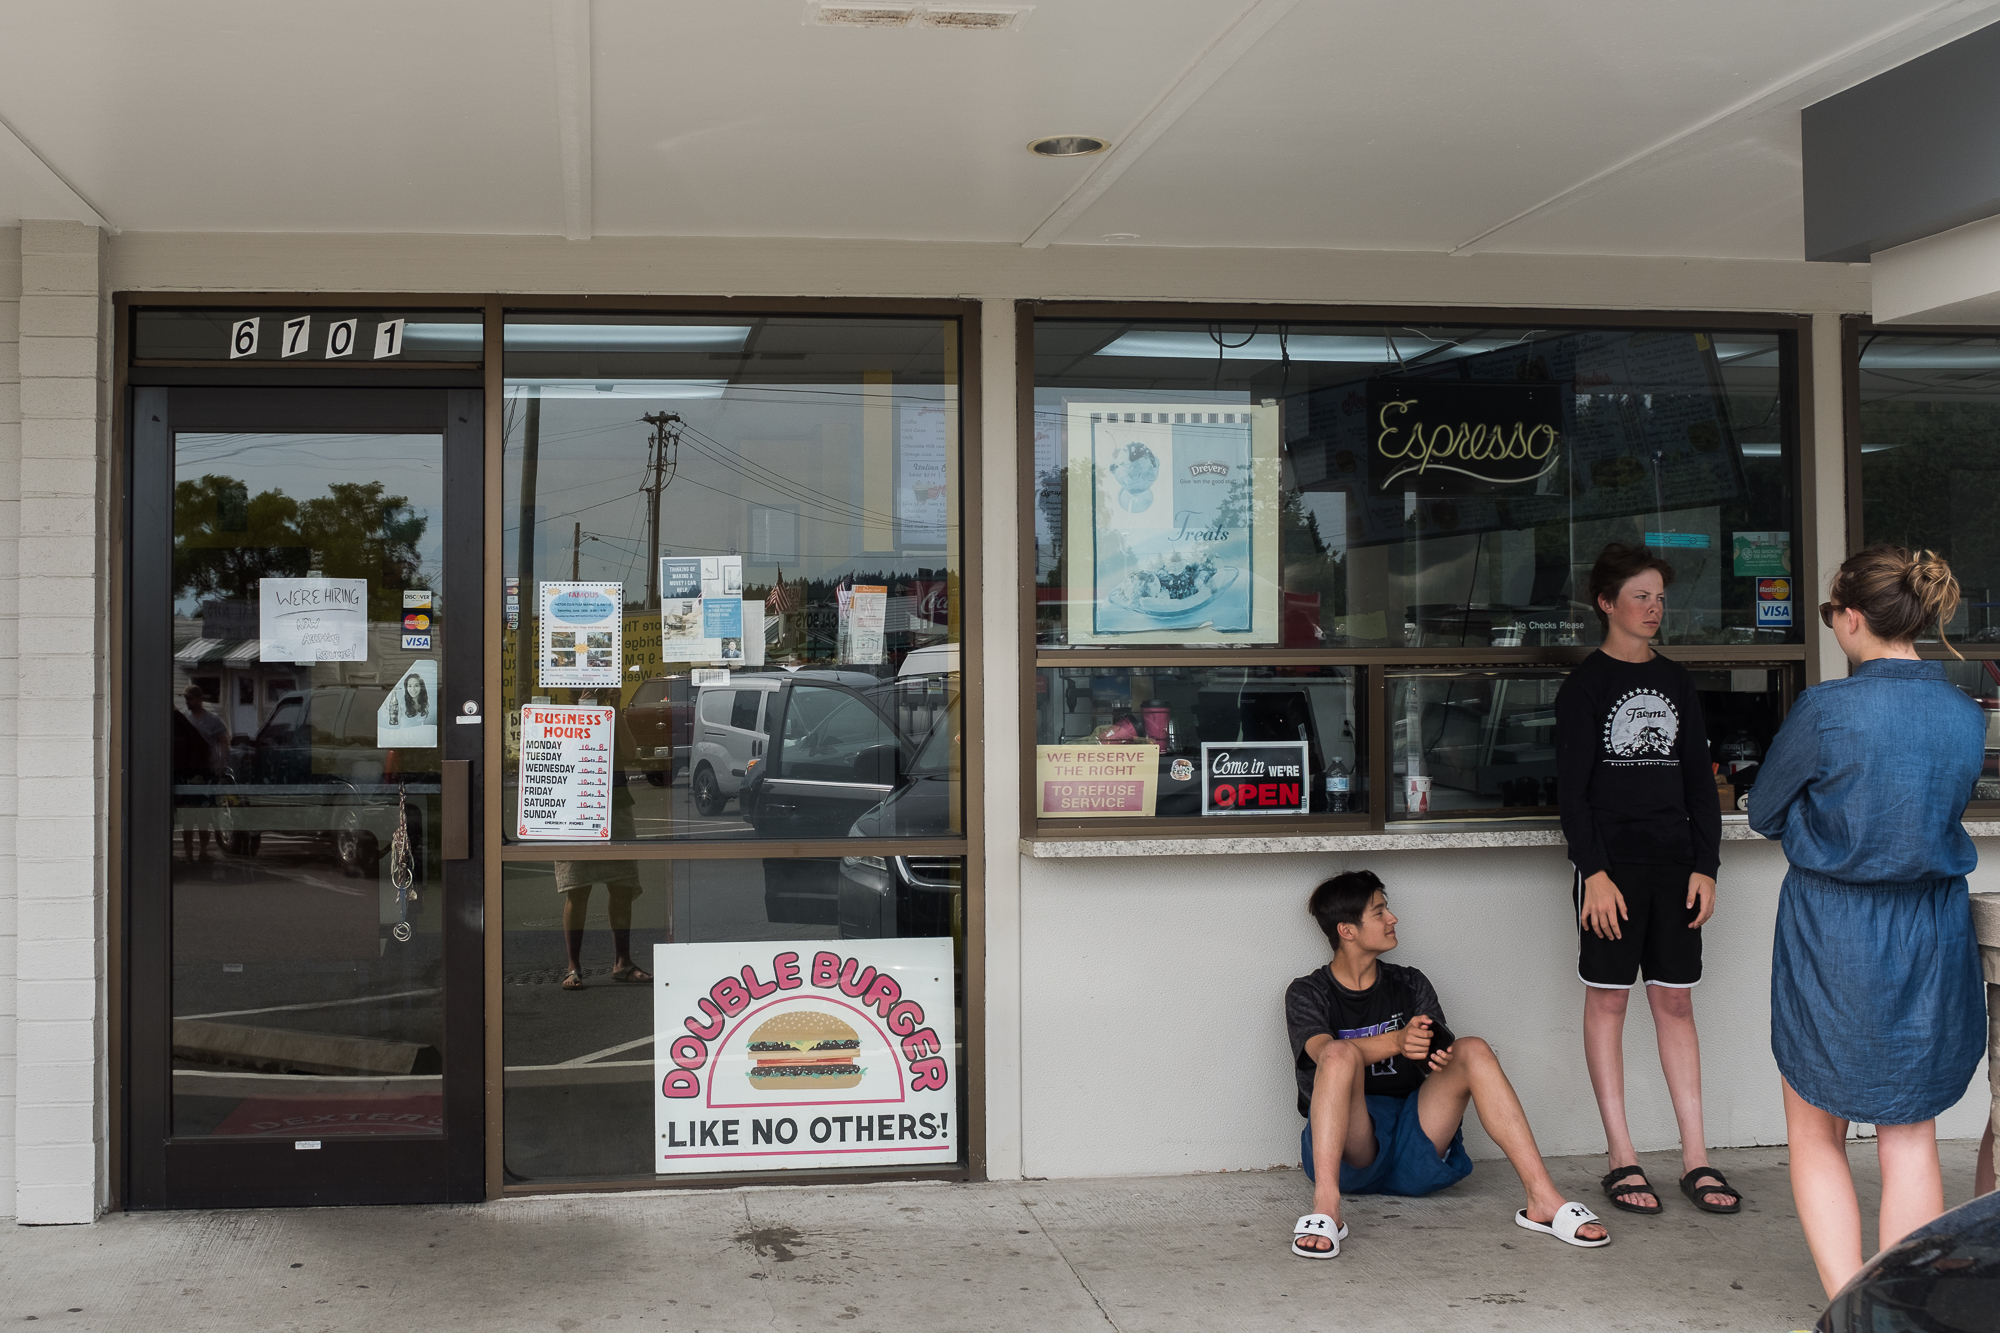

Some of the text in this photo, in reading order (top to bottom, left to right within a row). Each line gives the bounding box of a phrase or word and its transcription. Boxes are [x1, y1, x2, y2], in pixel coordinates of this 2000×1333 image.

[234, 319, 399, 356] 6701
[1378, 399, 1560, 475] Espresso
[913, 462, 939, 471] Italian
[1167, 510, 1230, 542] Treats
[276, 587, 359, 606] WE'RE HIRING
[1761, 605, 1790, 617] VISA
[296, 617, 321, 630] NOW
[1528, 621, 1557, 629] Checks
[1559, 621, 1584, 629] Please
[406, 637, 430, 647] VISA
[1625, 706, 1667, 724] Tacoma
[544, 727, 591, 739] HOURS
[526, 741, 562, 750] MONDAY
[526, 752, 562, 761] TUESDAY
[1047, 752, 1145, 764] WE RESERVE
[525, 763, 576, 773] WEDNESDAY
[1054, 765, 1136, 776] THE RIGHT
[1212, 752, 1248, 775] Come
[1250, 758, 1266, 774] in
[1268, 765, 1300, 777] WE'RE
[525, 775, 568, 785] THURSDAY
[524, 787, 553, 796] FRIDAY
[1052, 785, 1136, 797] TO REFUSE
[1213, 783, 1300, 807] OPEN
[524, 798, 566, 808] SATURDAY
[1061, 797, 1125, 809] SERVICE
[523, 810, 557, 819] SUNDAY
[662, 951, 948, 1100] DOUBLE BURGER
[668, 1112, 948, 1148] LIKE NO OTHERS!
